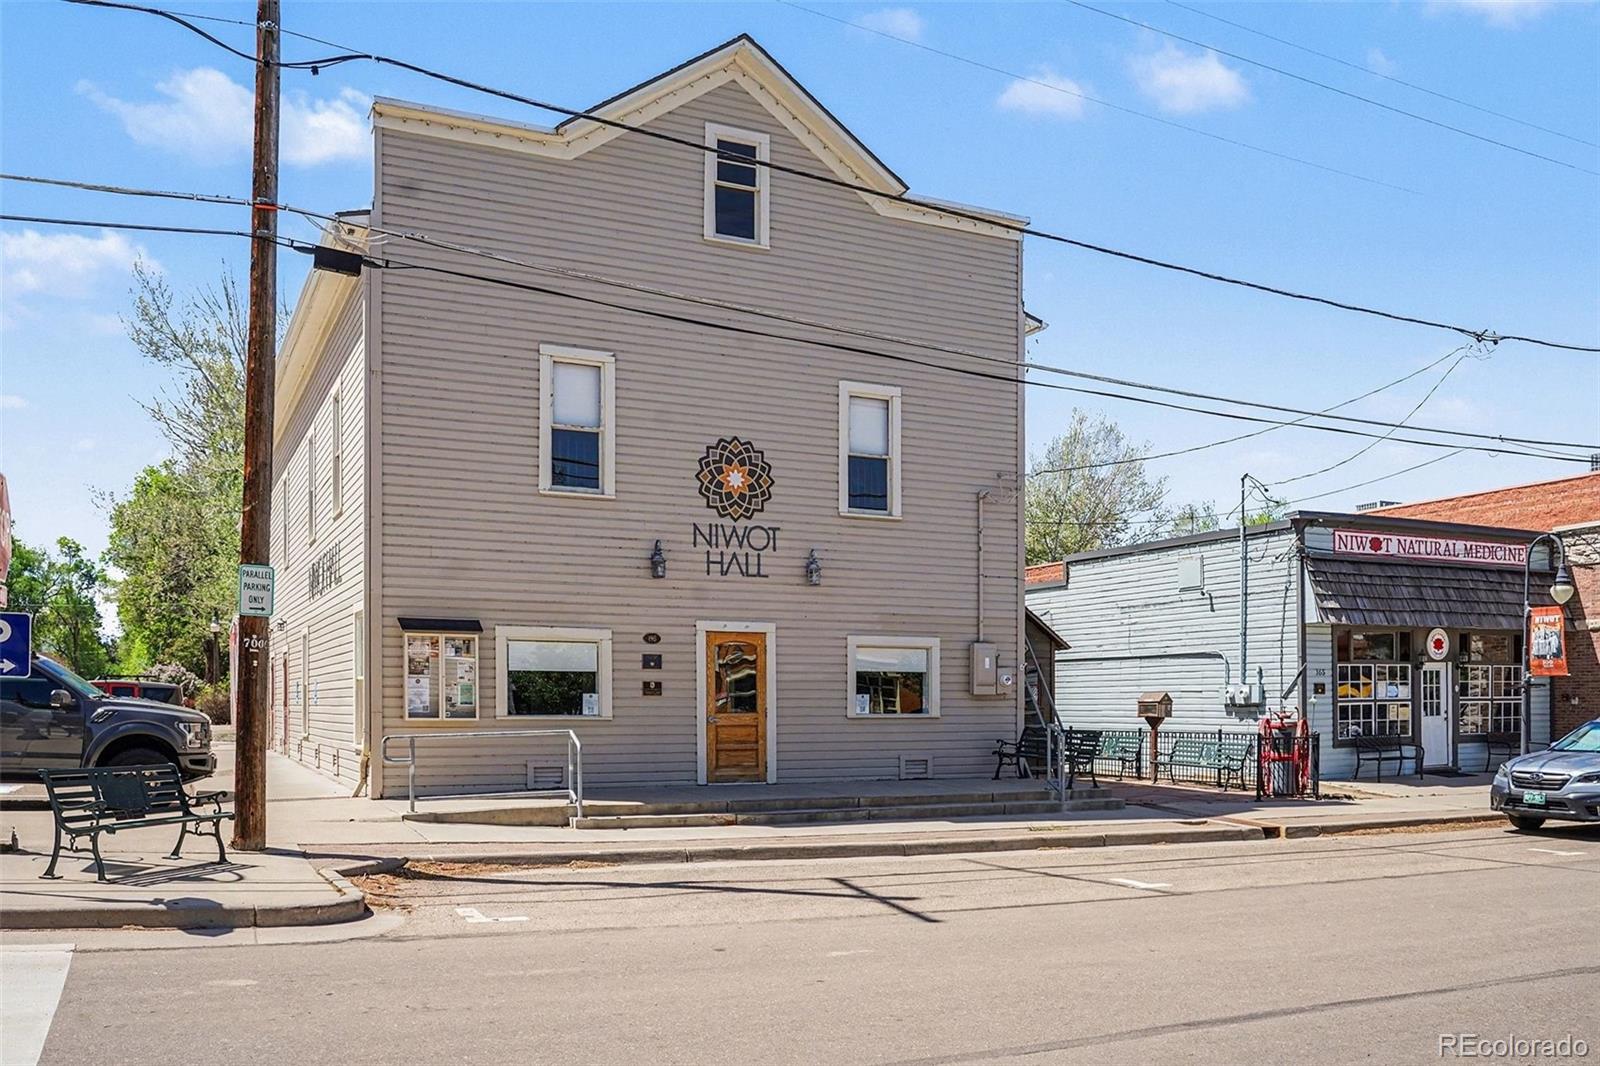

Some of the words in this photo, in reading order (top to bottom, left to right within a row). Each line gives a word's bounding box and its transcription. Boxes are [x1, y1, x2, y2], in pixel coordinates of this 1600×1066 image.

[692, 522, 781, 552] NIWOT
[1397, 538, 1460, 558] NATURAL
[1463, 543, 1525, 562] MEDICINE
[706, 550, 769, 578] HALL
[242, 569, 272, 580] PARALLEL
[243, 582, 271, 592] PARKING
[248, 595, 265, 604] ONLY
